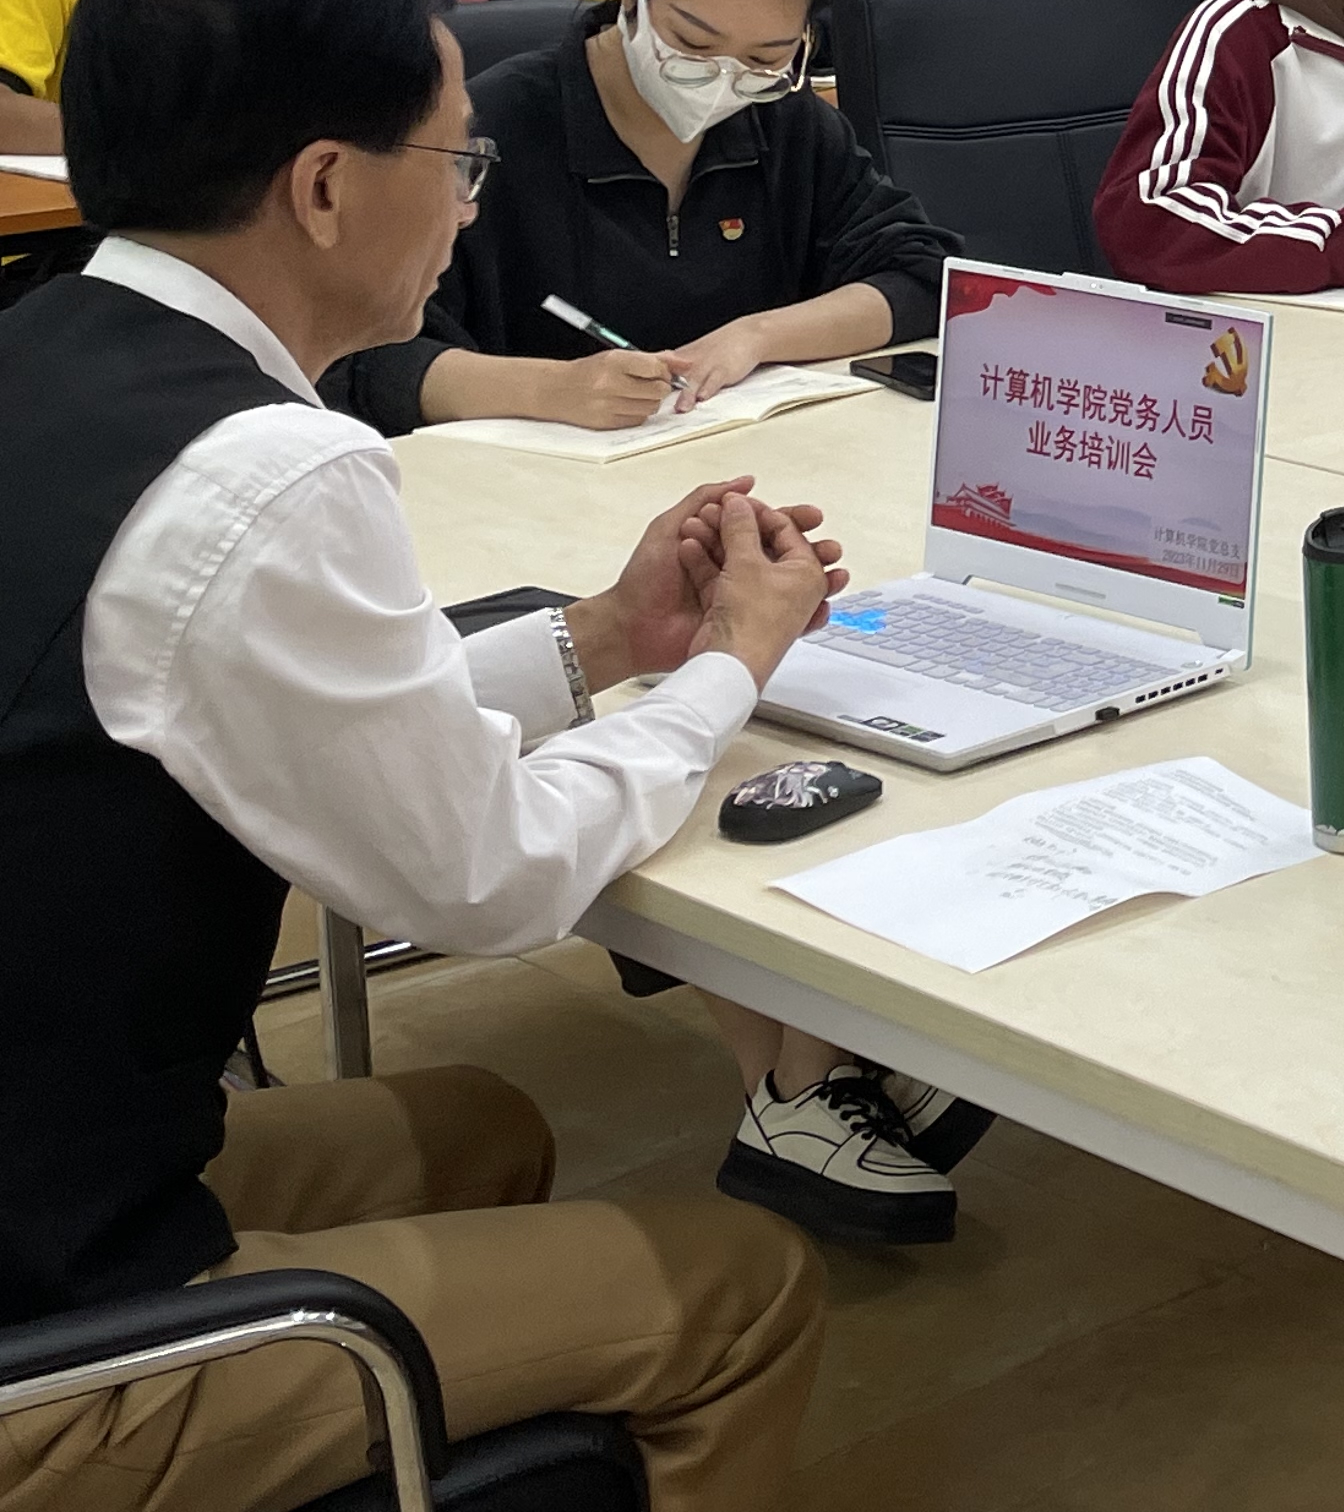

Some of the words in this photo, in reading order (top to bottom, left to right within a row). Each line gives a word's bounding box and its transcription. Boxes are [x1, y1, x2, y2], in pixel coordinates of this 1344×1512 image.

[979, 362, 1215, 446] 计算机学院党务人员
[1026, 419, 1159, 481] 业务培训会
[1153, 525, 1241, 560] 计算机学院党总支
